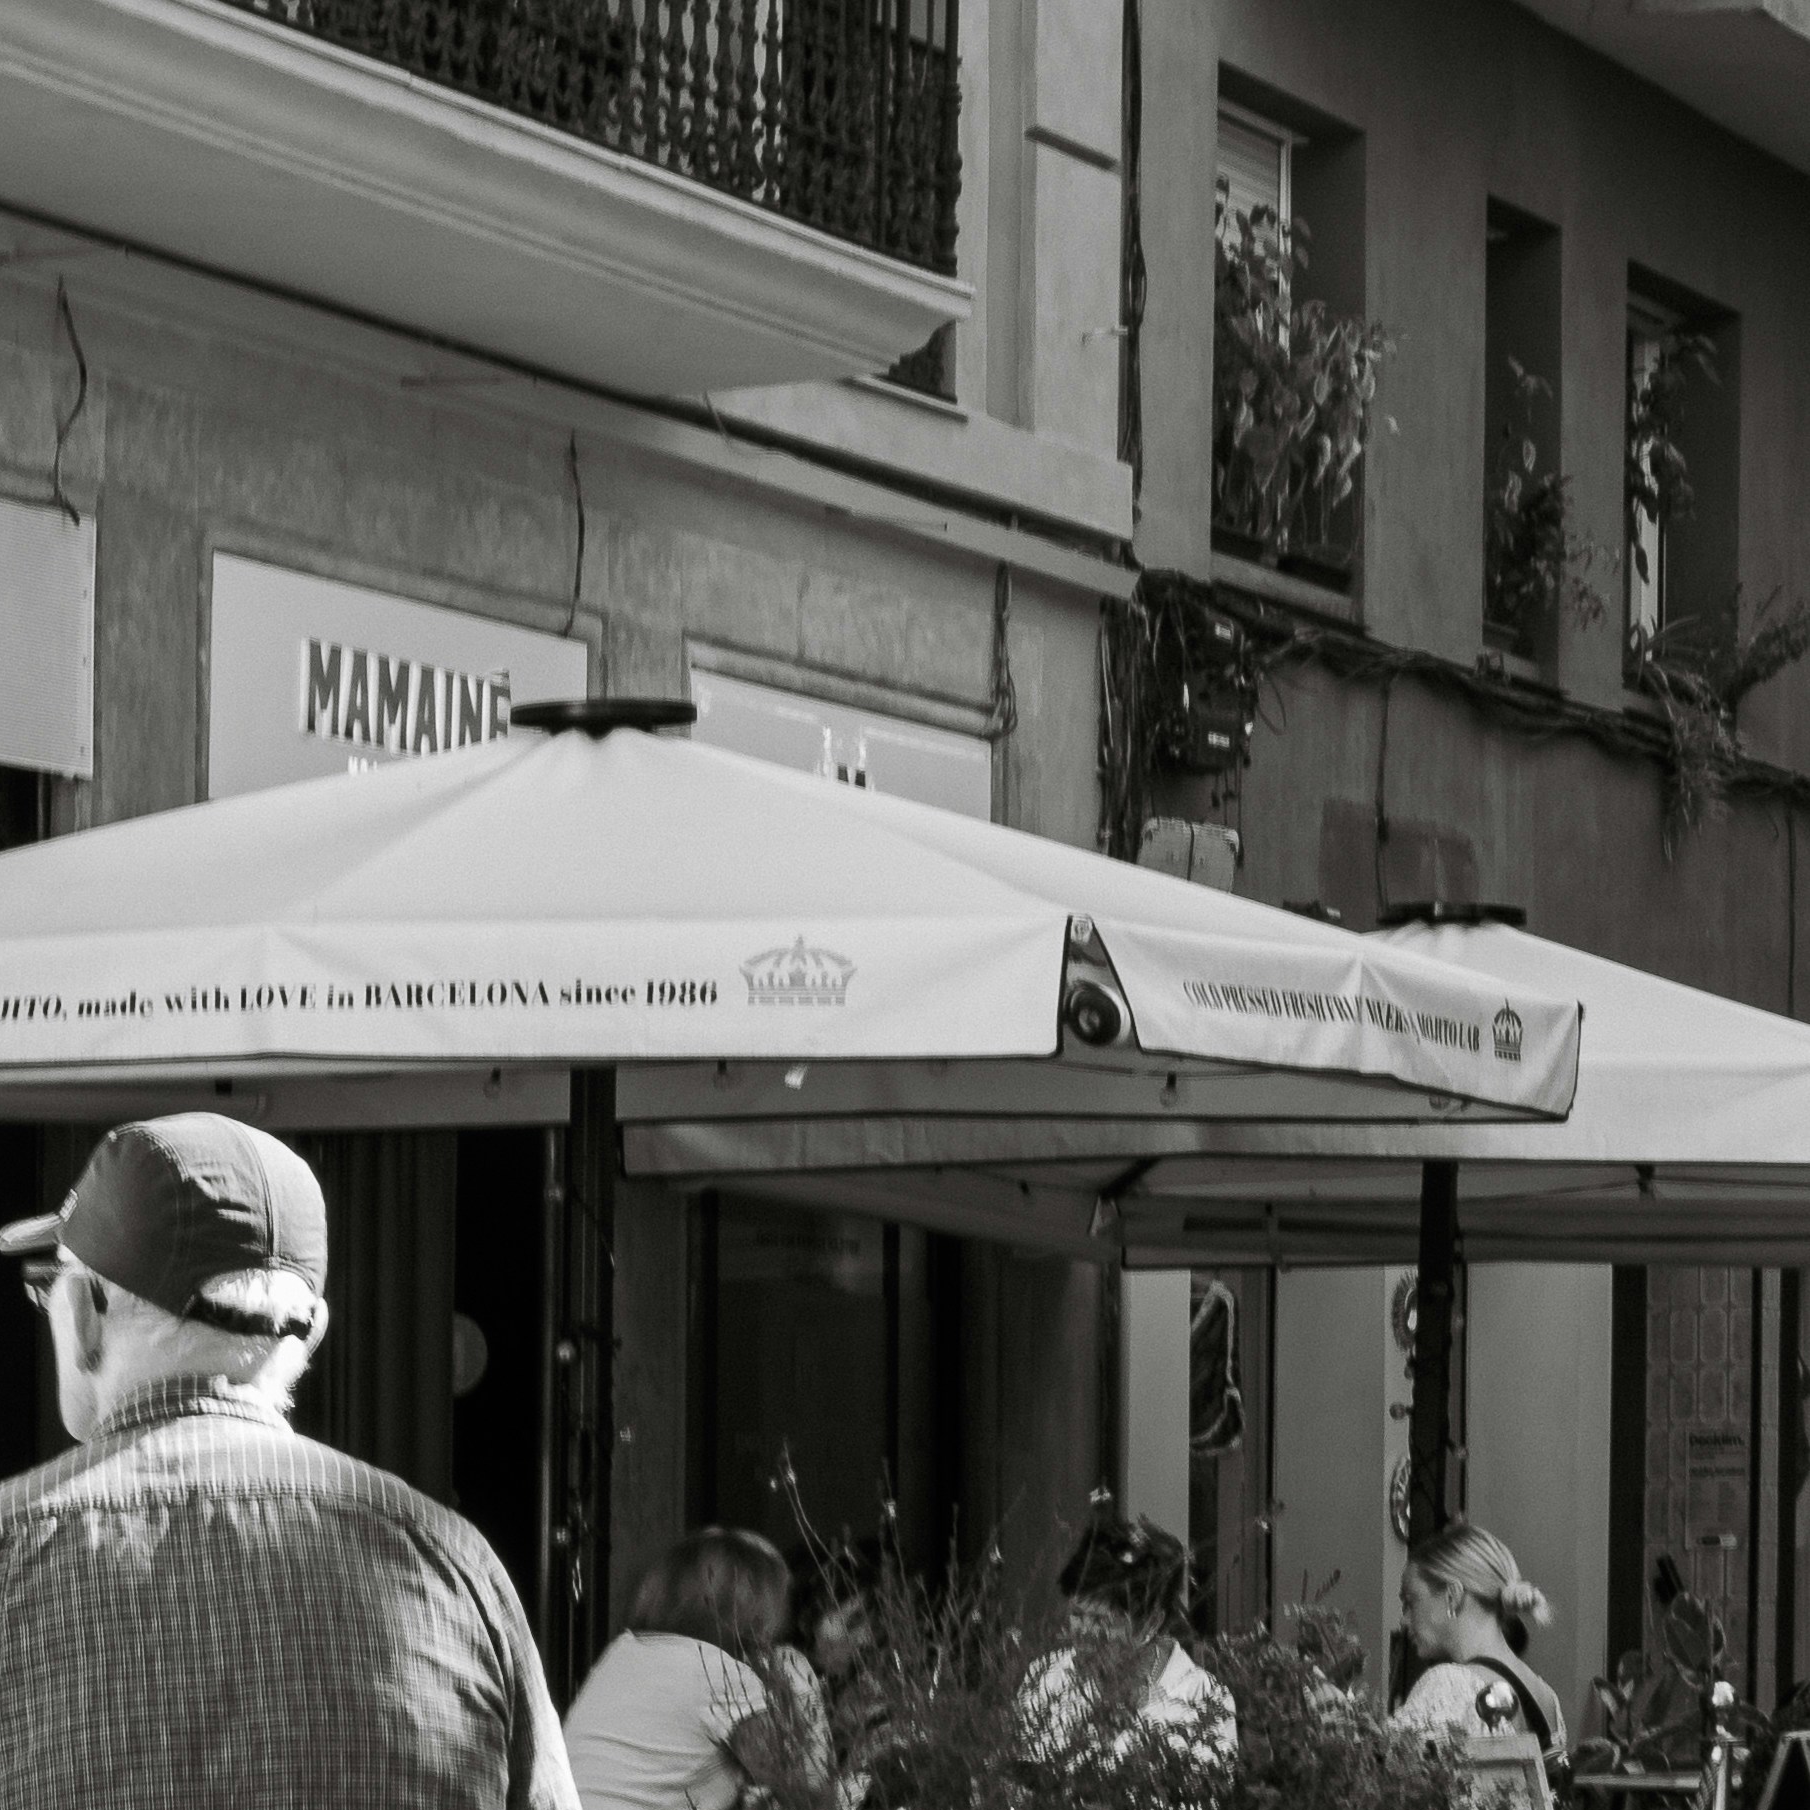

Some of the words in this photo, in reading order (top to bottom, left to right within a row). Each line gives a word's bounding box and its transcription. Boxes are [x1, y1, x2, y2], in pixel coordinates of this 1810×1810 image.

[77, 989, 154, 1020] made
[164, 983, 230, 1015] with
[239, 983, 317, 1013] LOVE
[326, 983, 355, 1012] in
[363, 979, 551, 1012] BARCELONA
[559, 978, 637, 1010] since
